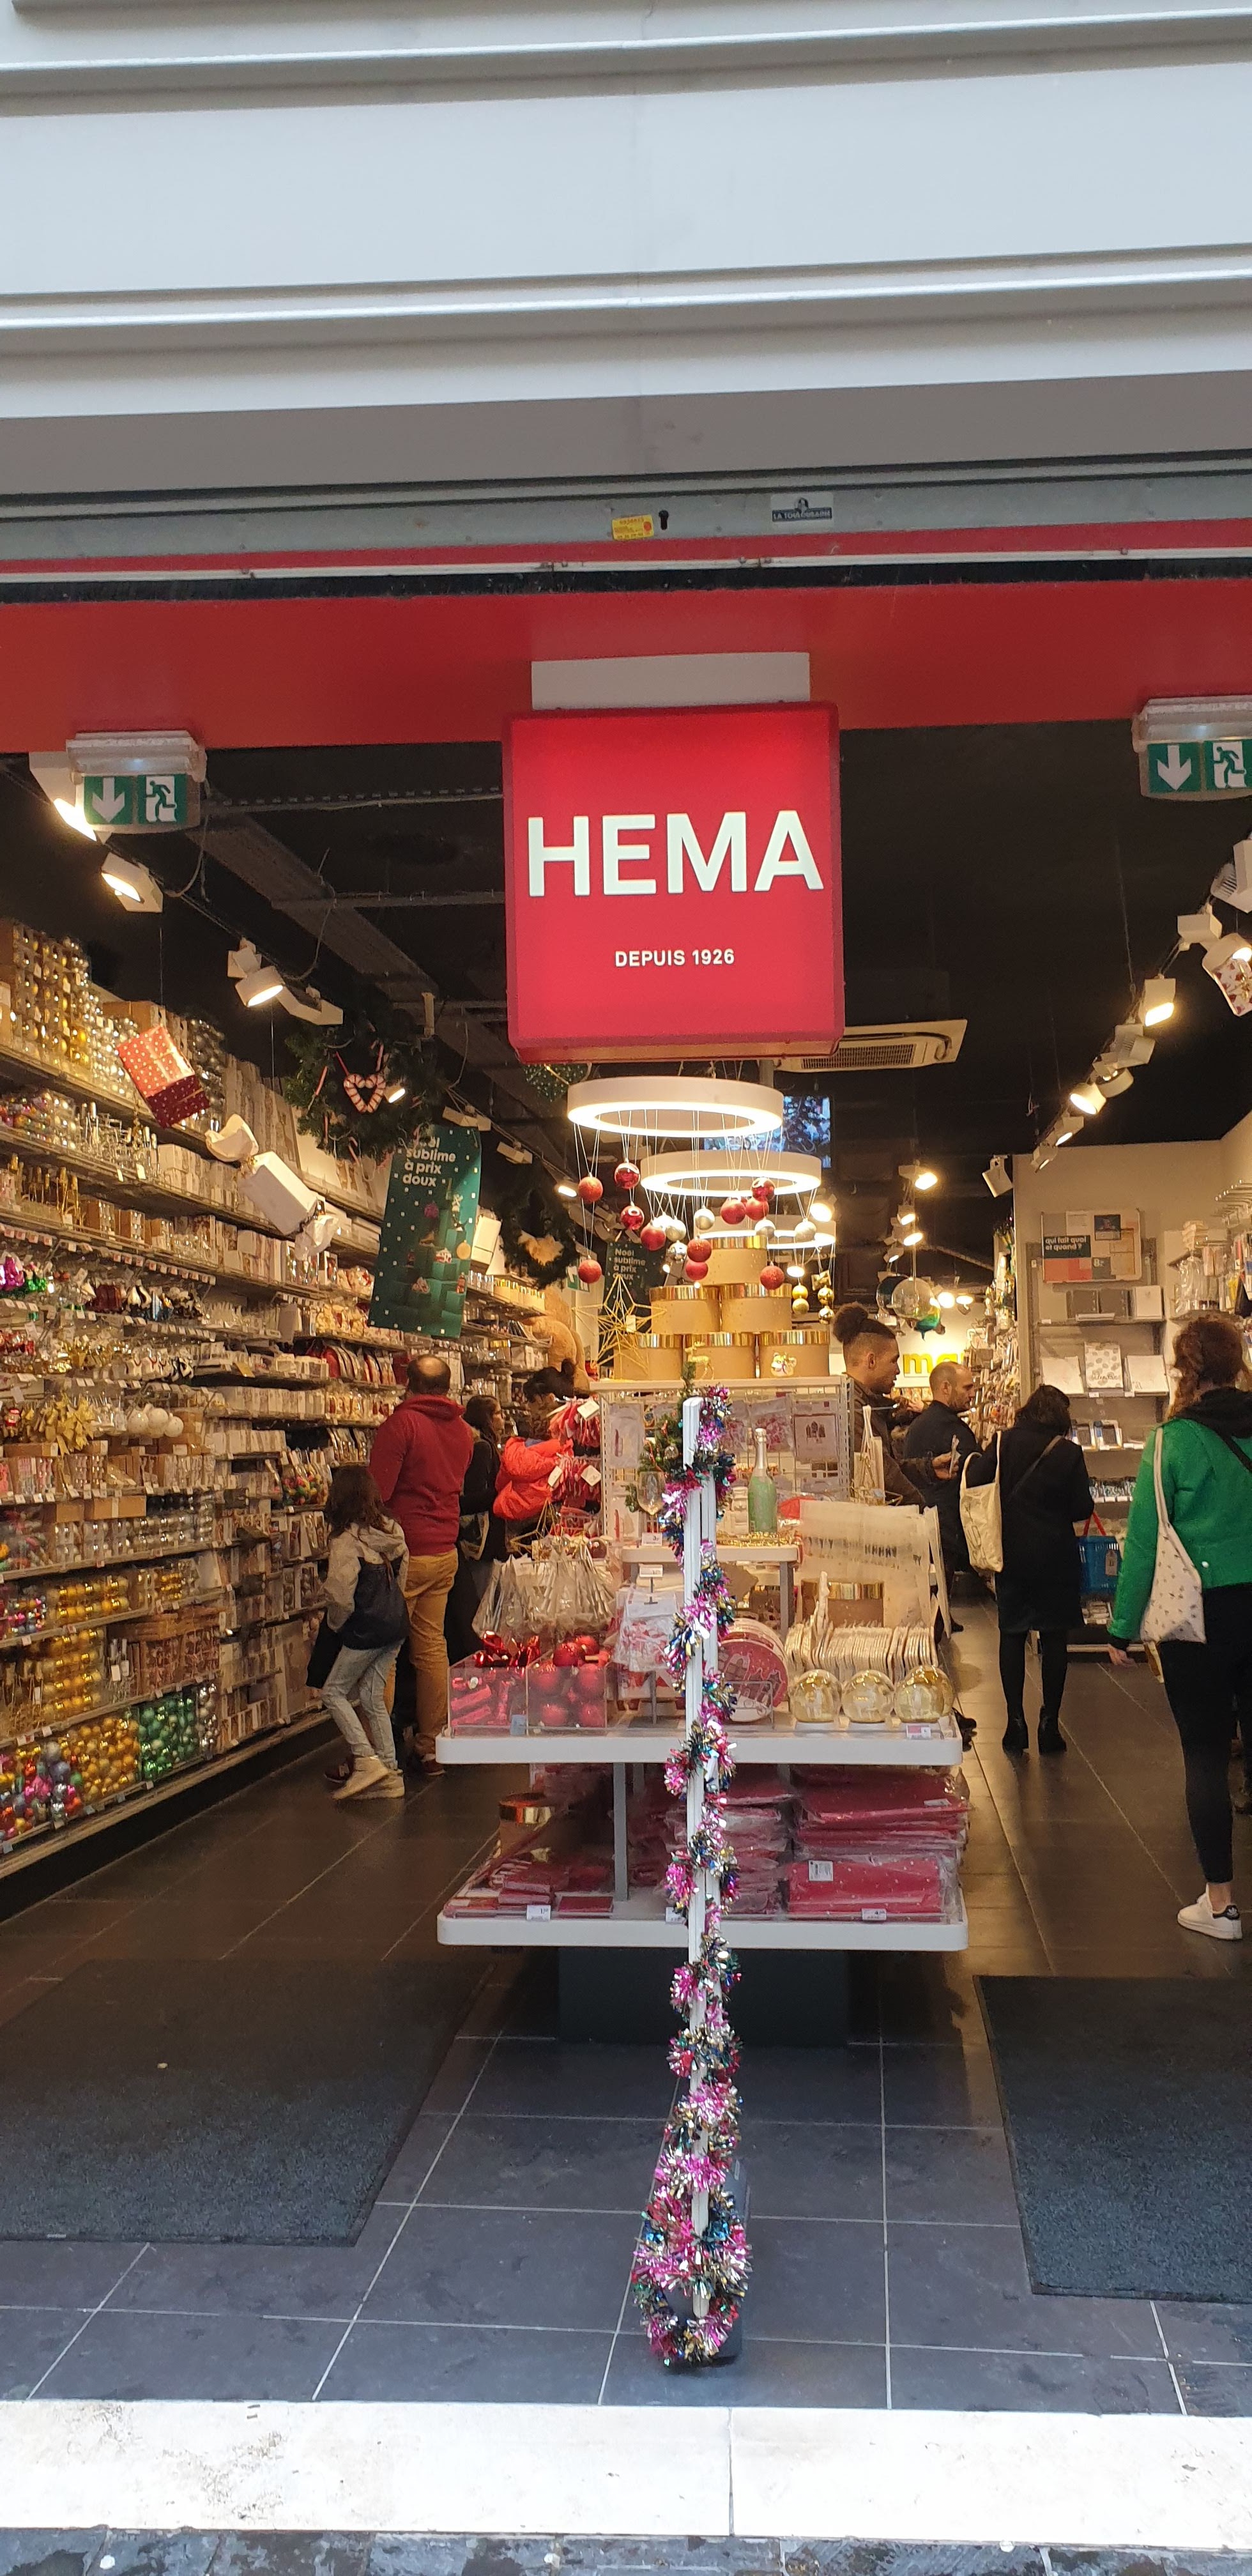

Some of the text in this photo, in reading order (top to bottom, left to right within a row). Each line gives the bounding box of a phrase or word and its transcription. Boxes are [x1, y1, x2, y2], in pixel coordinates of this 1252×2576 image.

[528, 810, 824, 897] HEMA
[615, 948, 735, 967] DEPUIS 1926
[406, 1148, 456, 1162] sublime
[416, 1161, 441, 1174] prix
[402, 1173, 436, 1187] doux
[1045, 1237, 1057, 1245] qui
[1070, 1236, 1087, 1245] quoi
[614, 1257, 646, 1266] sublime
[620, 1264, 637, 1273] prix
